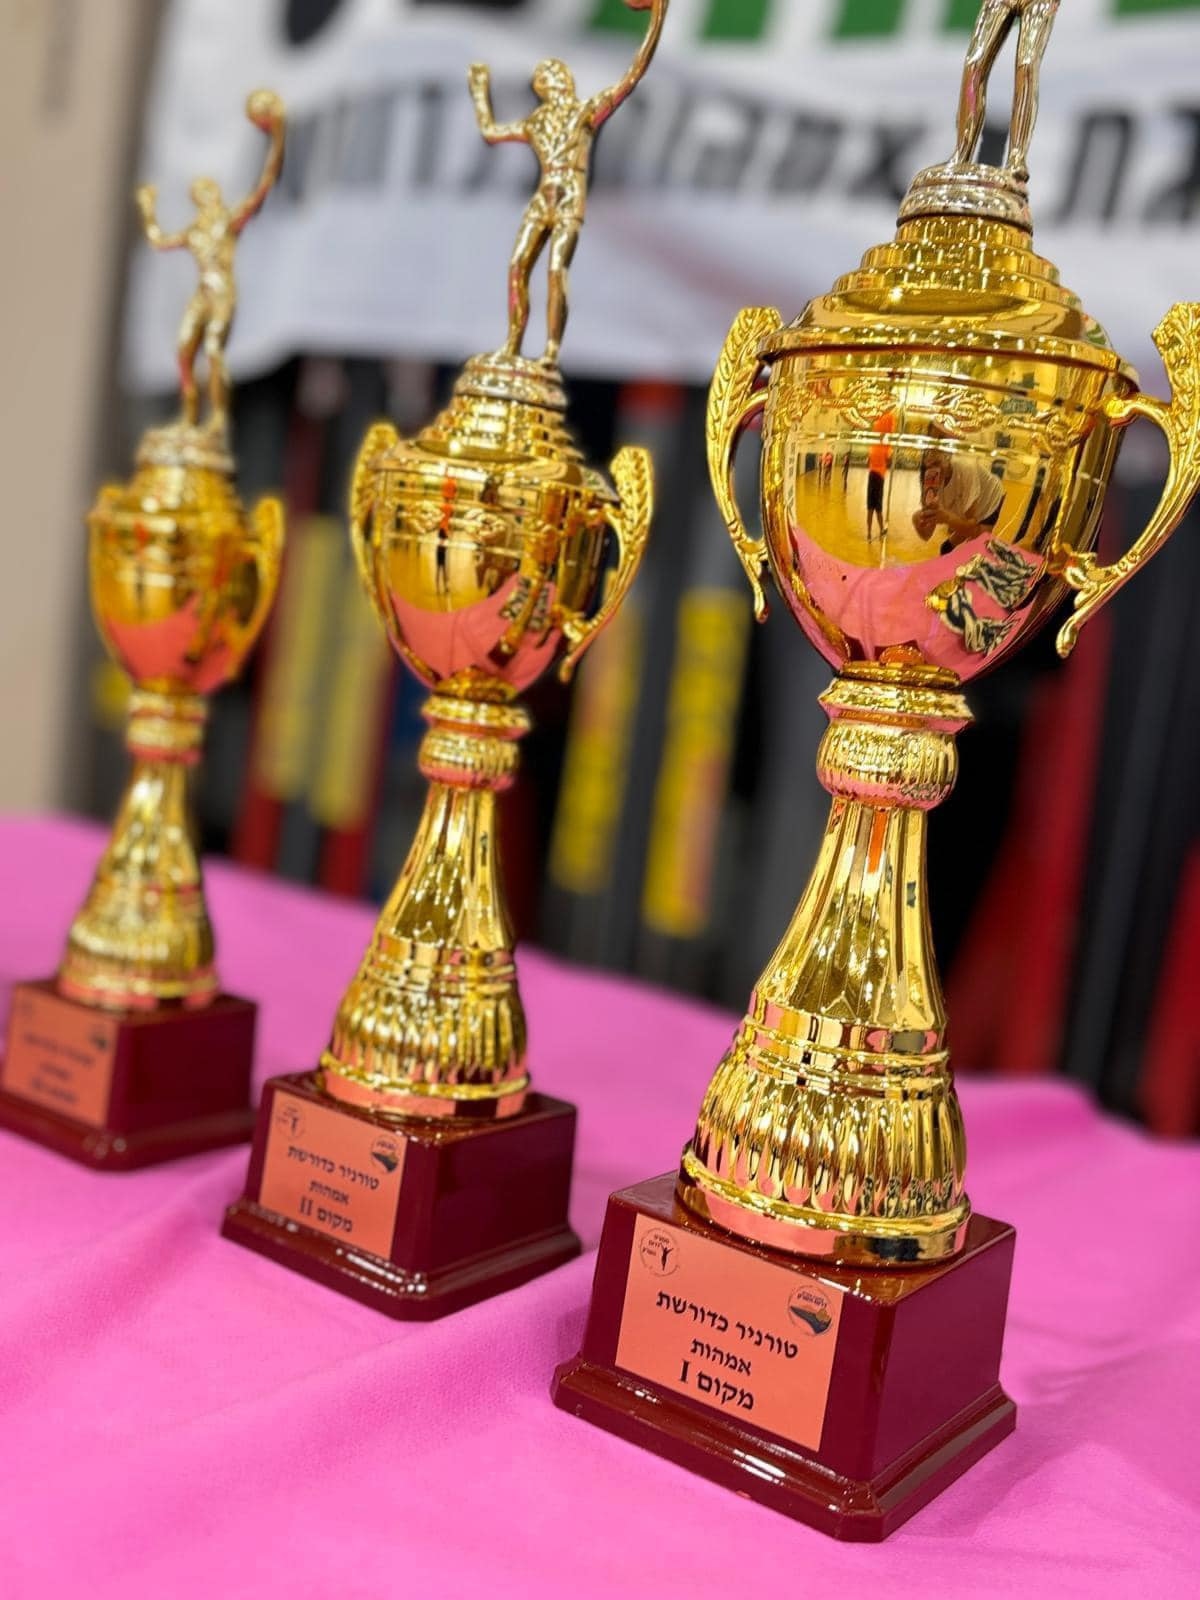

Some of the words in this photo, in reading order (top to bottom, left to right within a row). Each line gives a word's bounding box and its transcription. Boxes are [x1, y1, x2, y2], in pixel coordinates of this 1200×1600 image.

[288, 1146, 335, 1173] כדורשת
[339, 1165, 379, 1190] טורניר
[309, 1180, 349, 1205] אמהות
[317, 1207, 353, 1232] מקום
[656, 1290, 729, 1332] כדורשת
[735, 1321, 798, 1359] טורניר
[690, 1338, 752, 1376] אמהות
[680, 1360, 689, 1383] I
[697, 1371, 754, 1411] מקום
